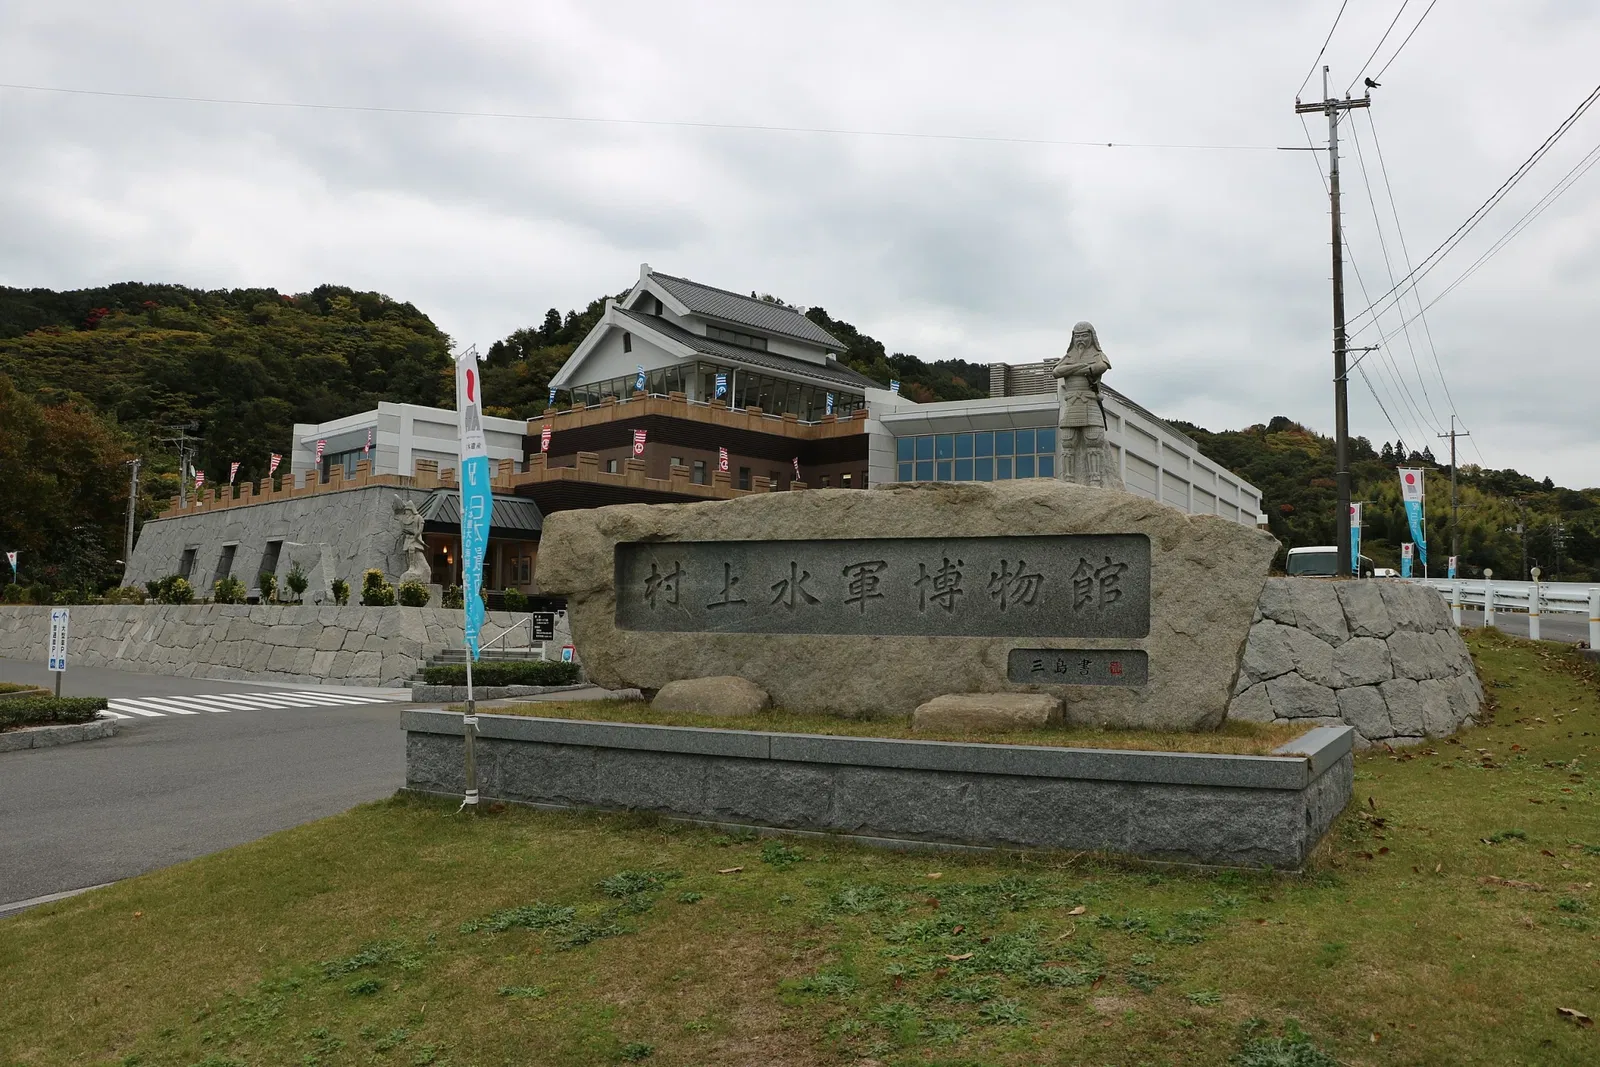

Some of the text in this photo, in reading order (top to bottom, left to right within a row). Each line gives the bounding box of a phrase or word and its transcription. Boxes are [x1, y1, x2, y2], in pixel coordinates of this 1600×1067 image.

[643, 556, 1130, 615] 村上水軍博物館
